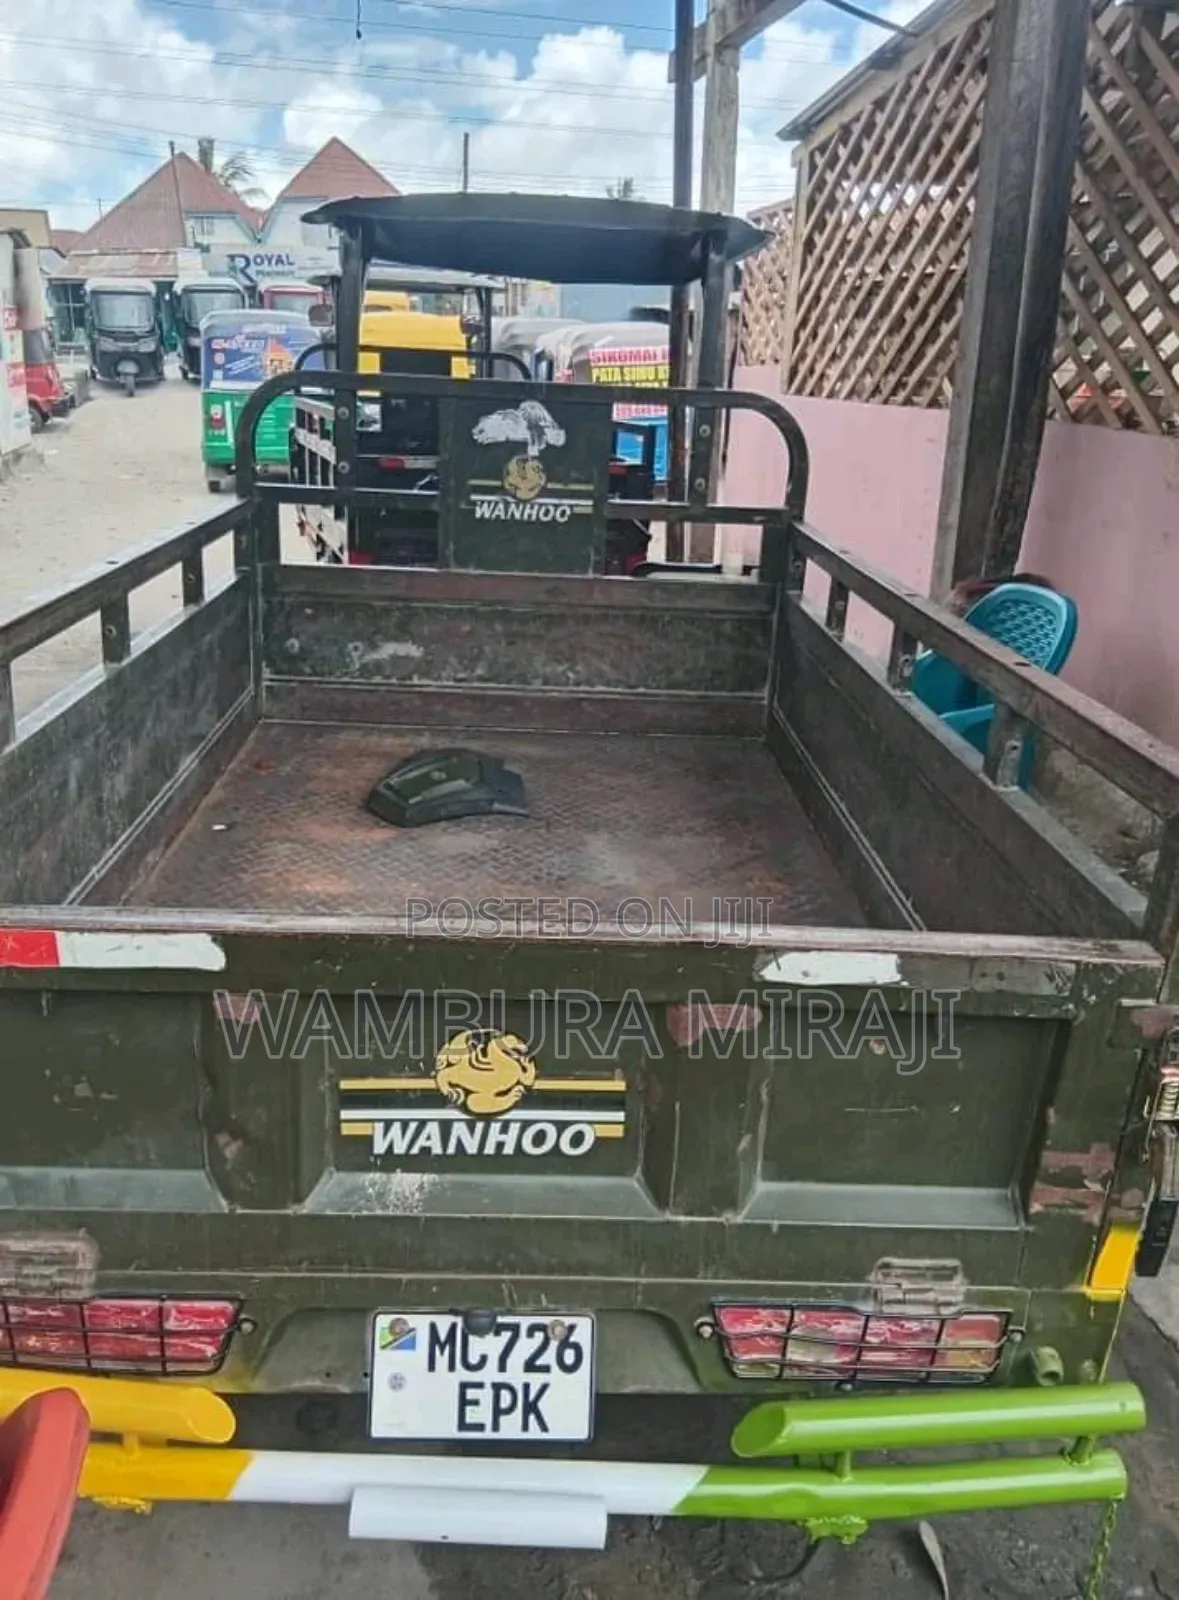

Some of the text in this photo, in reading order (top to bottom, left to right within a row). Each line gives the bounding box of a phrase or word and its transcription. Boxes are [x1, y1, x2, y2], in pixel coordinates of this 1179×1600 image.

[225, 252, 295, 285] ROYAL
[474, 501, 571, 523] WANHOO
[372, 1121, 597, 1156] WANHOO
[457, 1380, 550, 1433] EPK
